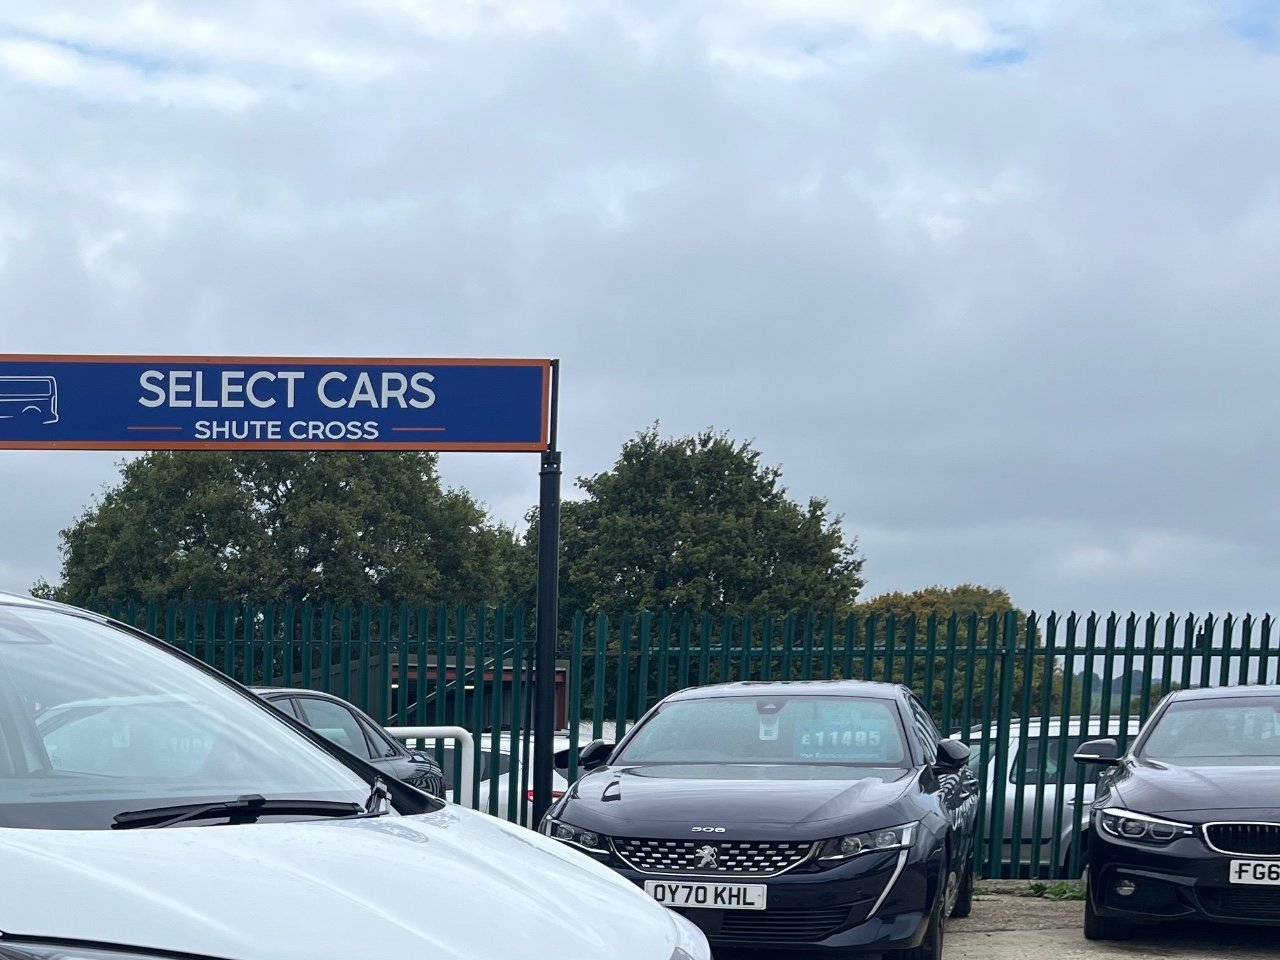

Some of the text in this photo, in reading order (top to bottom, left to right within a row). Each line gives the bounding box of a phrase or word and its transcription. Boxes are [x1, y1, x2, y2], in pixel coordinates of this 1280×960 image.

[138, 370, 436, 408] SELECT CARS
[194, 420, 379, 440] SHUTE CROSS
[1238, 863, 1280, 881] FG6
[653, 883, 756, 906] OY70 KHL
